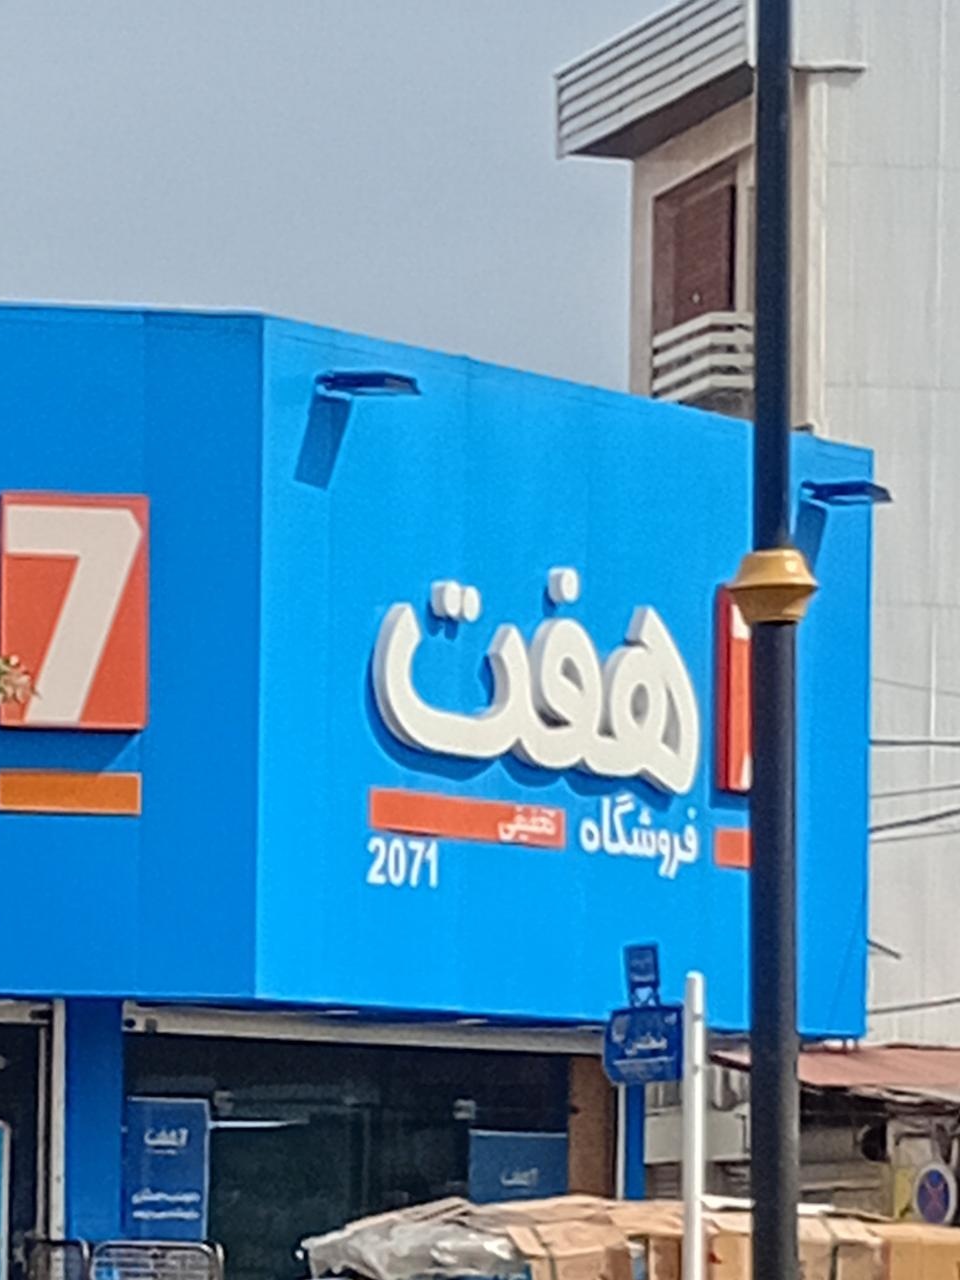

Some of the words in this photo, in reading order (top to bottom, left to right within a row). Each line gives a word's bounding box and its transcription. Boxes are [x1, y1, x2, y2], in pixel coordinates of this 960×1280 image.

[4, 504, 142, 727] 7
[374, 566, 699, 796] هفت
[367, 839, 439, 887] 2071
[580, 796, 699, 879] فروشگاه
